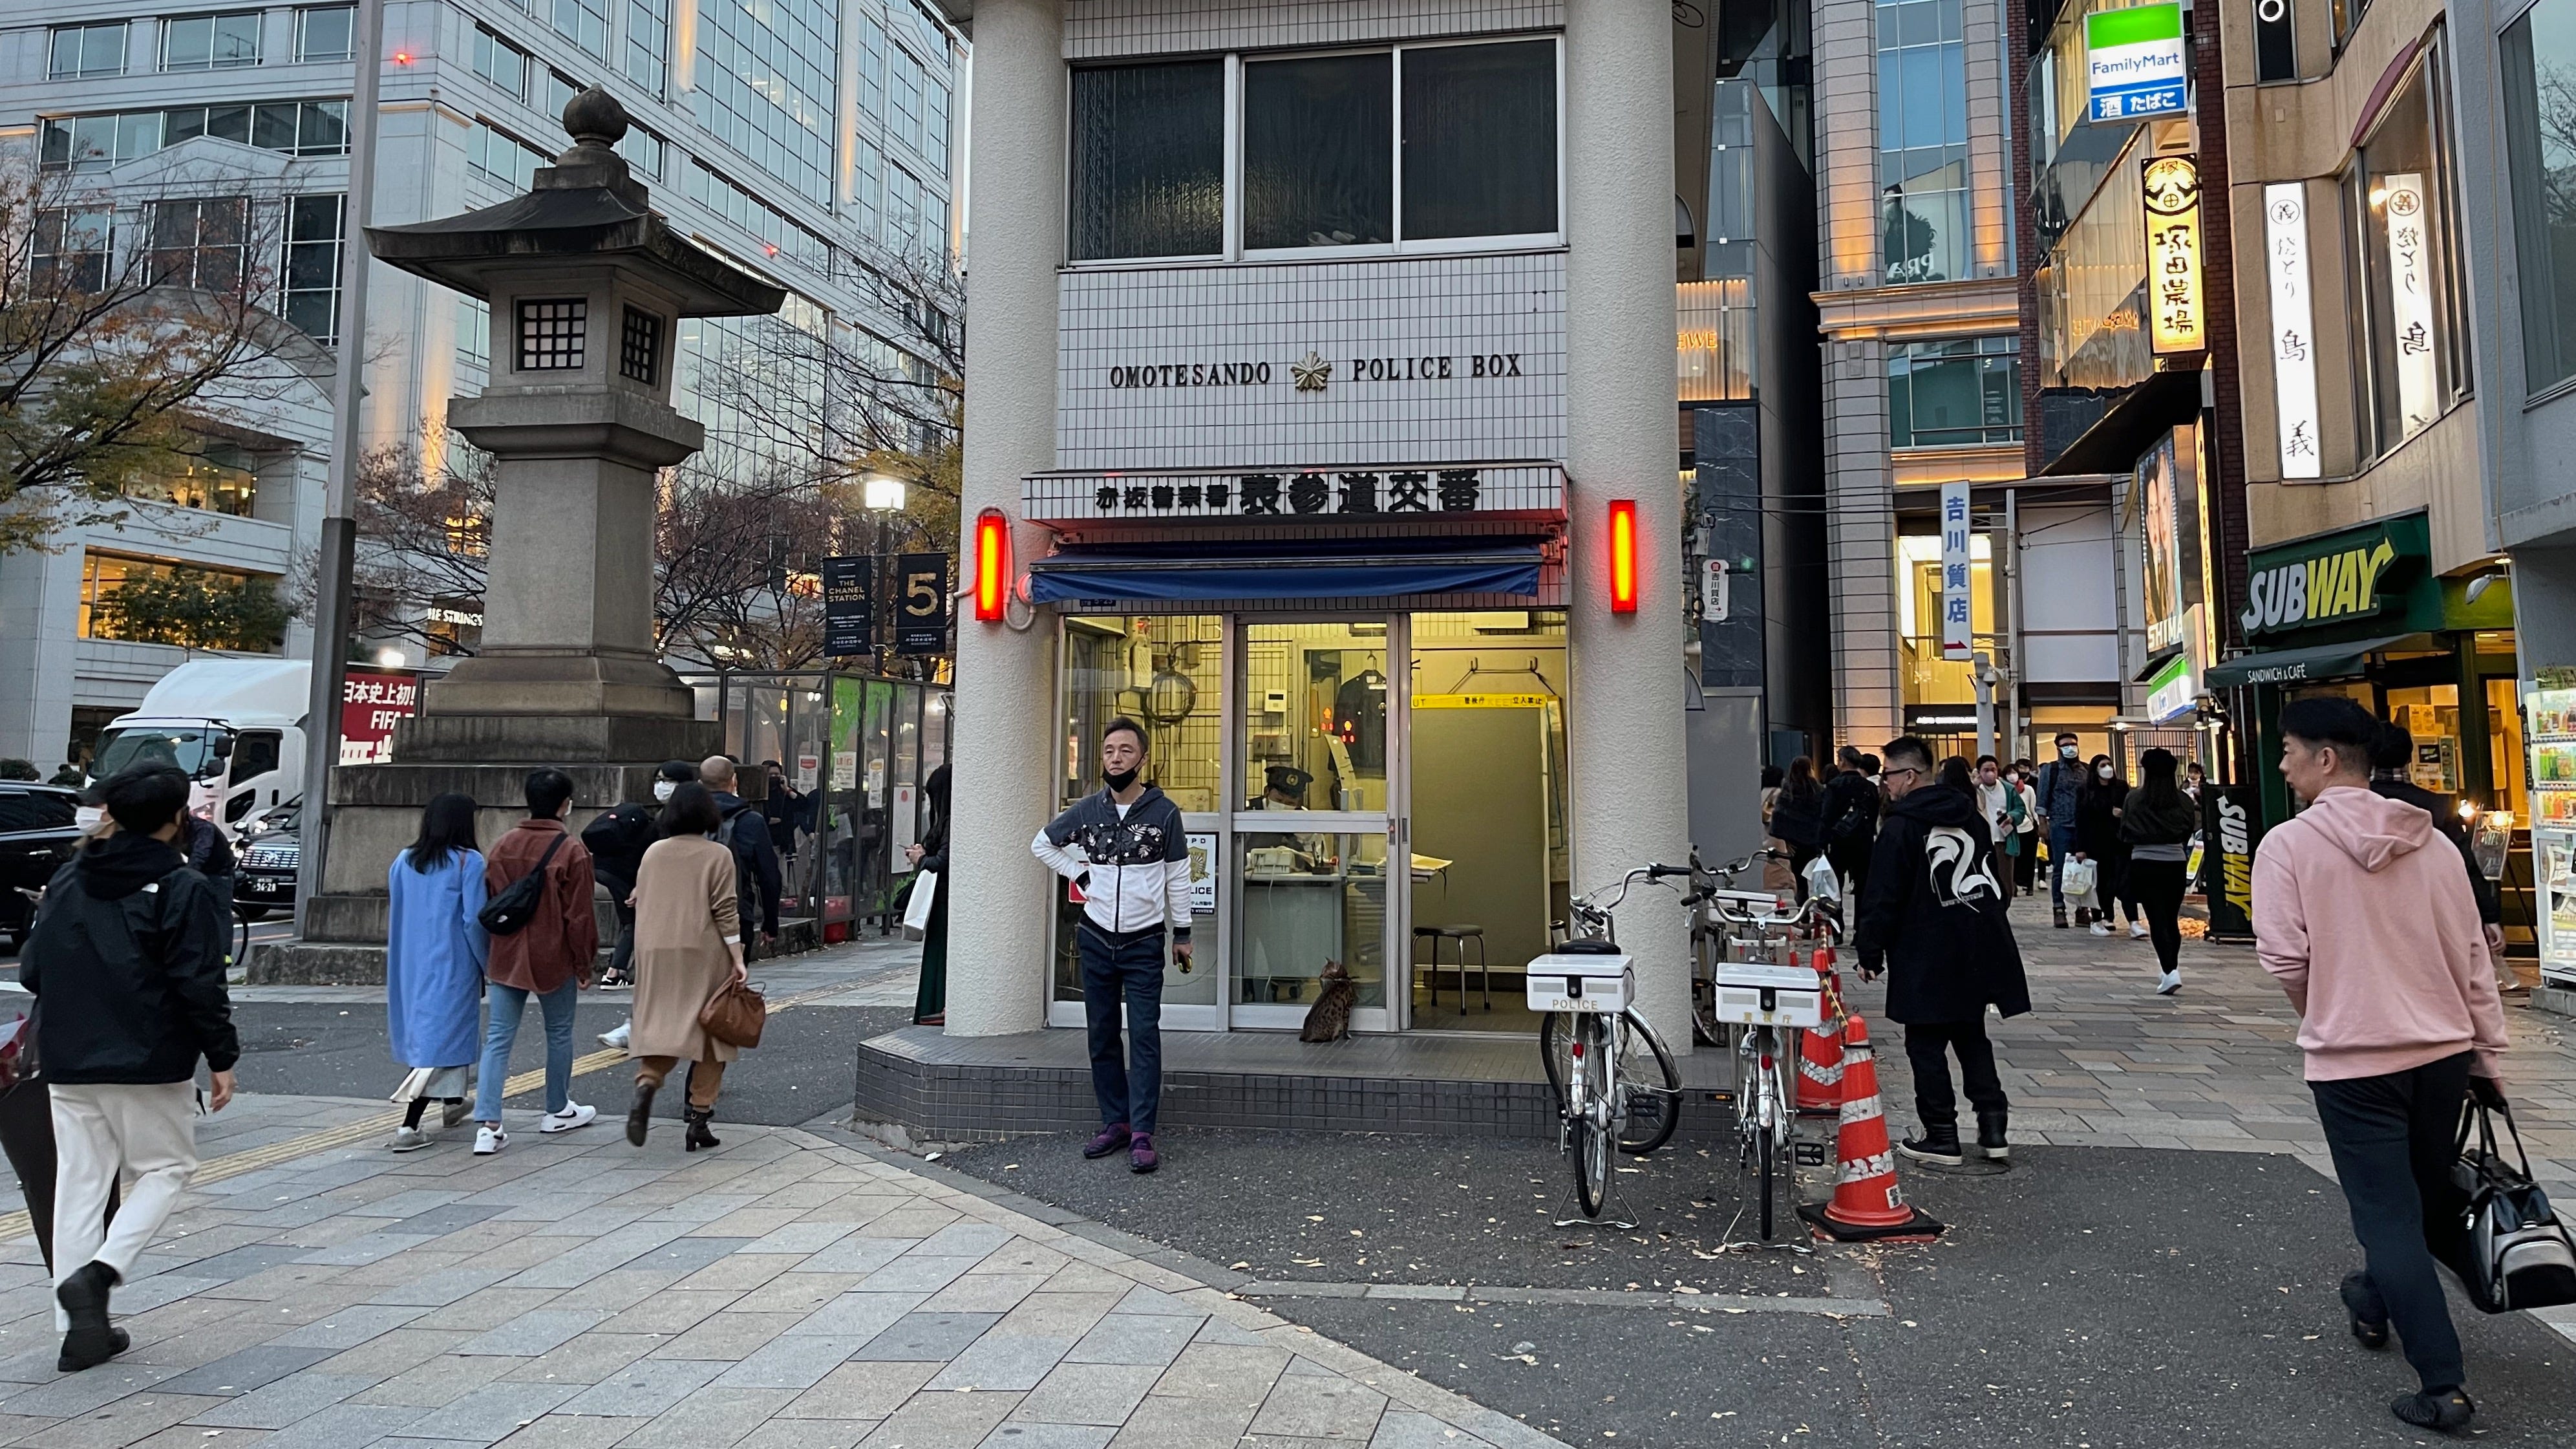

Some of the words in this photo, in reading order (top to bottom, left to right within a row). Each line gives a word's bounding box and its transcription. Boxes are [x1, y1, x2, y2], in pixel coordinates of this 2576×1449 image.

[2092, 52, 2180, 74] FamilyMart
[2100, 96, 2122, 117] 酒
[2131, 92, 2177, 112] たばこ
[1110, 361, 1270, 387] OMOTESANDO
[1352, 357, 1451, 381] POLICE
[1471, 354, 1522, 377] BOX
[1096, 484, 1229, 510] 赤坂警察署
[1240, 470, 1480, 513] 表参道交番
[829, 594, 866, 602] STATION
[906, 573, 938, 616] 5
[2241, 537, 2394, 634] SUBWAY
[443, 609, 483, 627] STRINGS
[2248, 667, 2283, 683] SANDWICH
[2288, 662, 2306, 679] CAFÉ
[2217, 795, 2252, 921] SUBWAY
[1552, 999, 1598, 1010] POLICE
